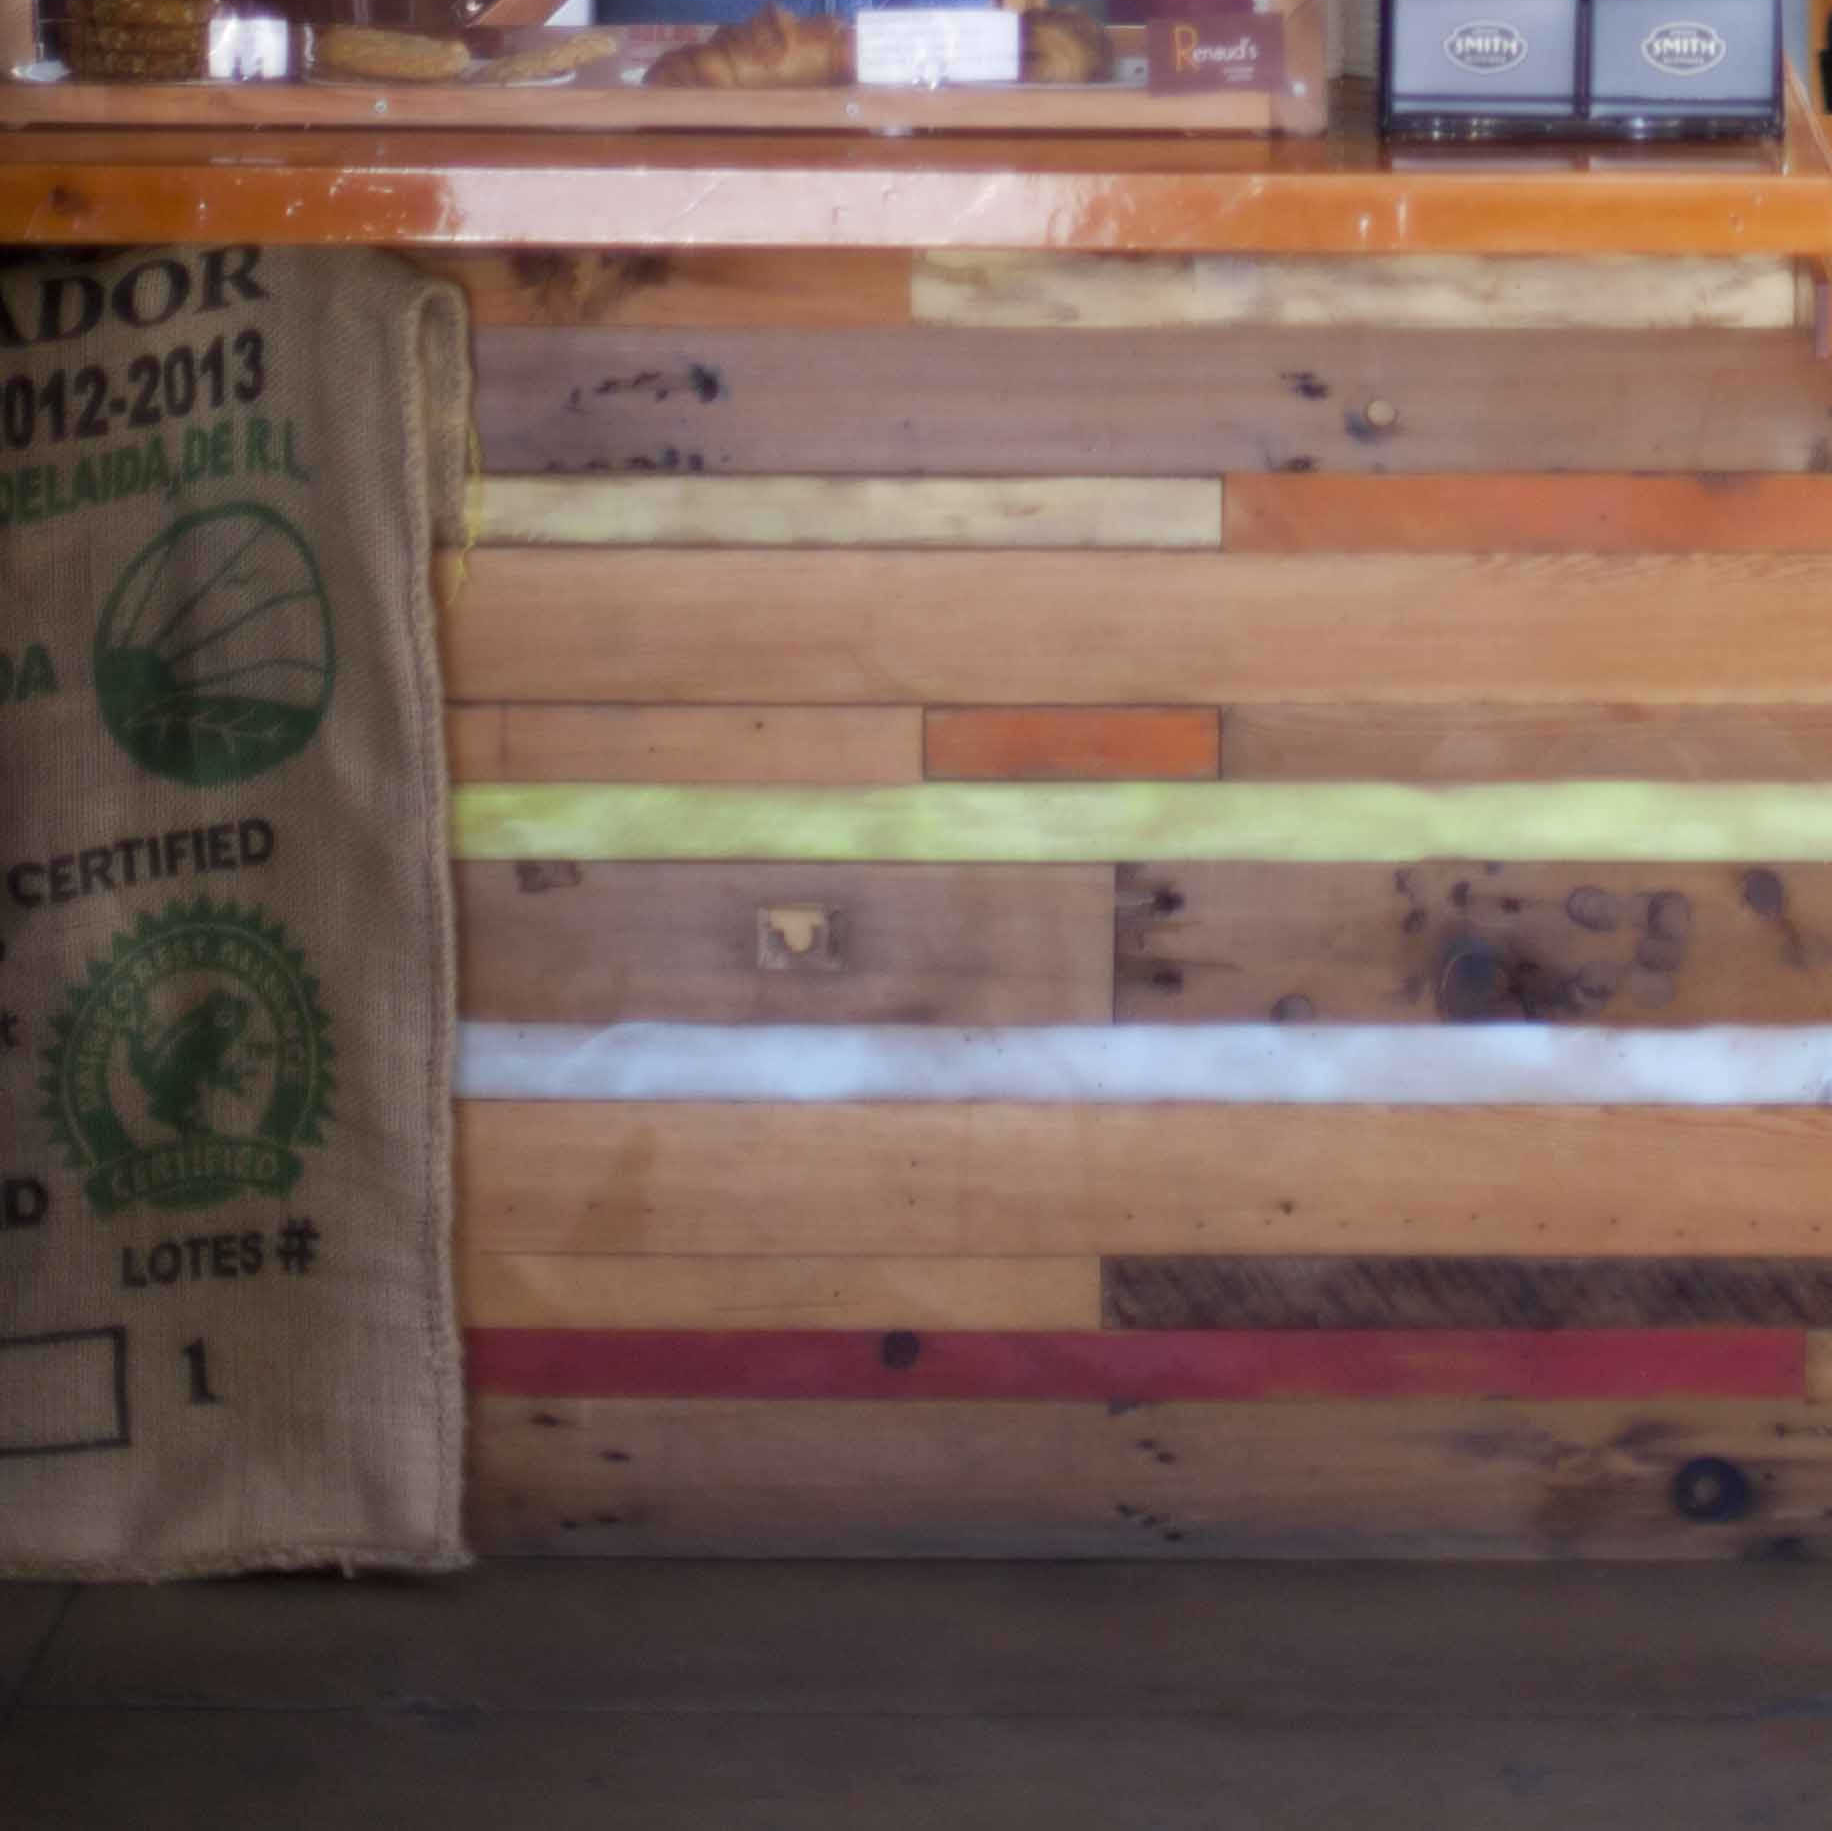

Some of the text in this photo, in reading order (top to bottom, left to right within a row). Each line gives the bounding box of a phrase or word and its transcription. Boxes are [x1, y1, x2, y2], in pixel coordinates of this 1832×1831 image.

[1455, 35, 1519, 55] SMITH
[1652, 35, 1716, 56] SMITH
[7, 818, 275, 909] CERTIFIED
[121, 1231, 264, 1289] LOTES
